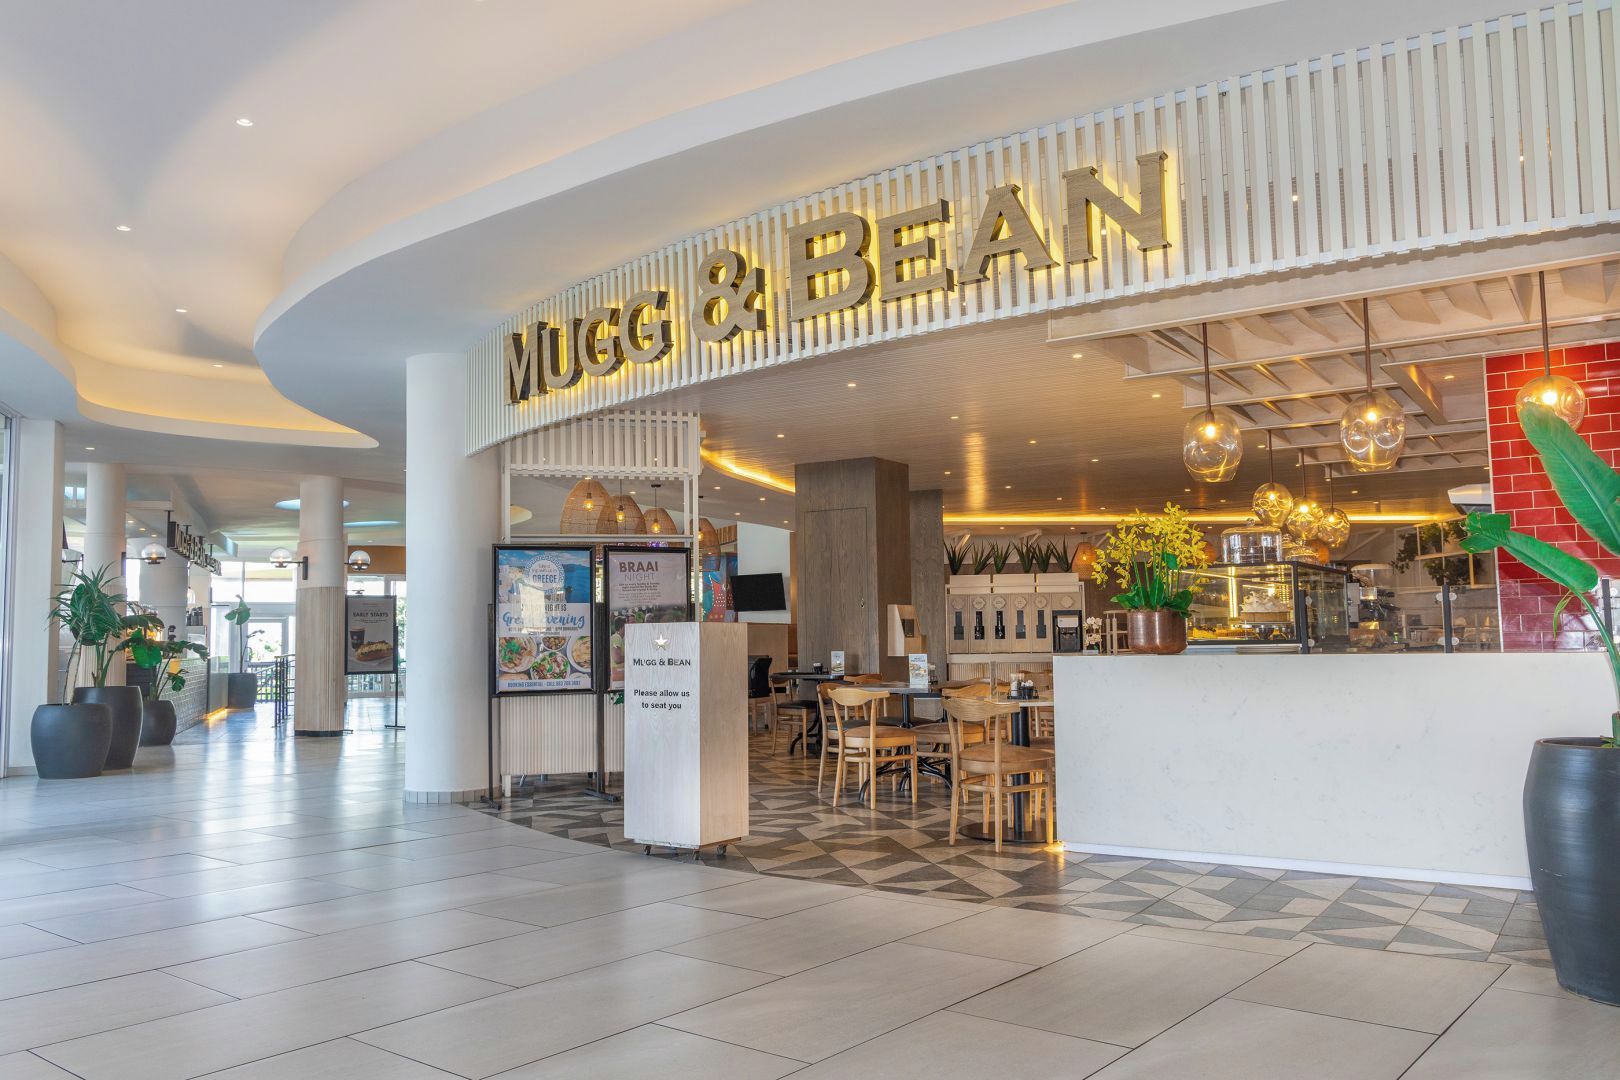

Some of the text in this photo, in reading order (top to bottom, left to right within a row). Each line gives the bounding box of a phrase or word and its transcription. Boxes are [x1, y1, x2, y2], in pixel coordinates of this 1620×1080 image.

[504, 150, 1173, 406] MUGG & BEAN
[619, 561, 659, 573] BRAAI
[624, 572, 655, 581] NIGHT
[633, 658, 691, 666] MUGG & BEAN
[633, 689, 658, 697] Please
[659, 689, 679, 697] allow
[641, 701, 682, 711] to seat you
